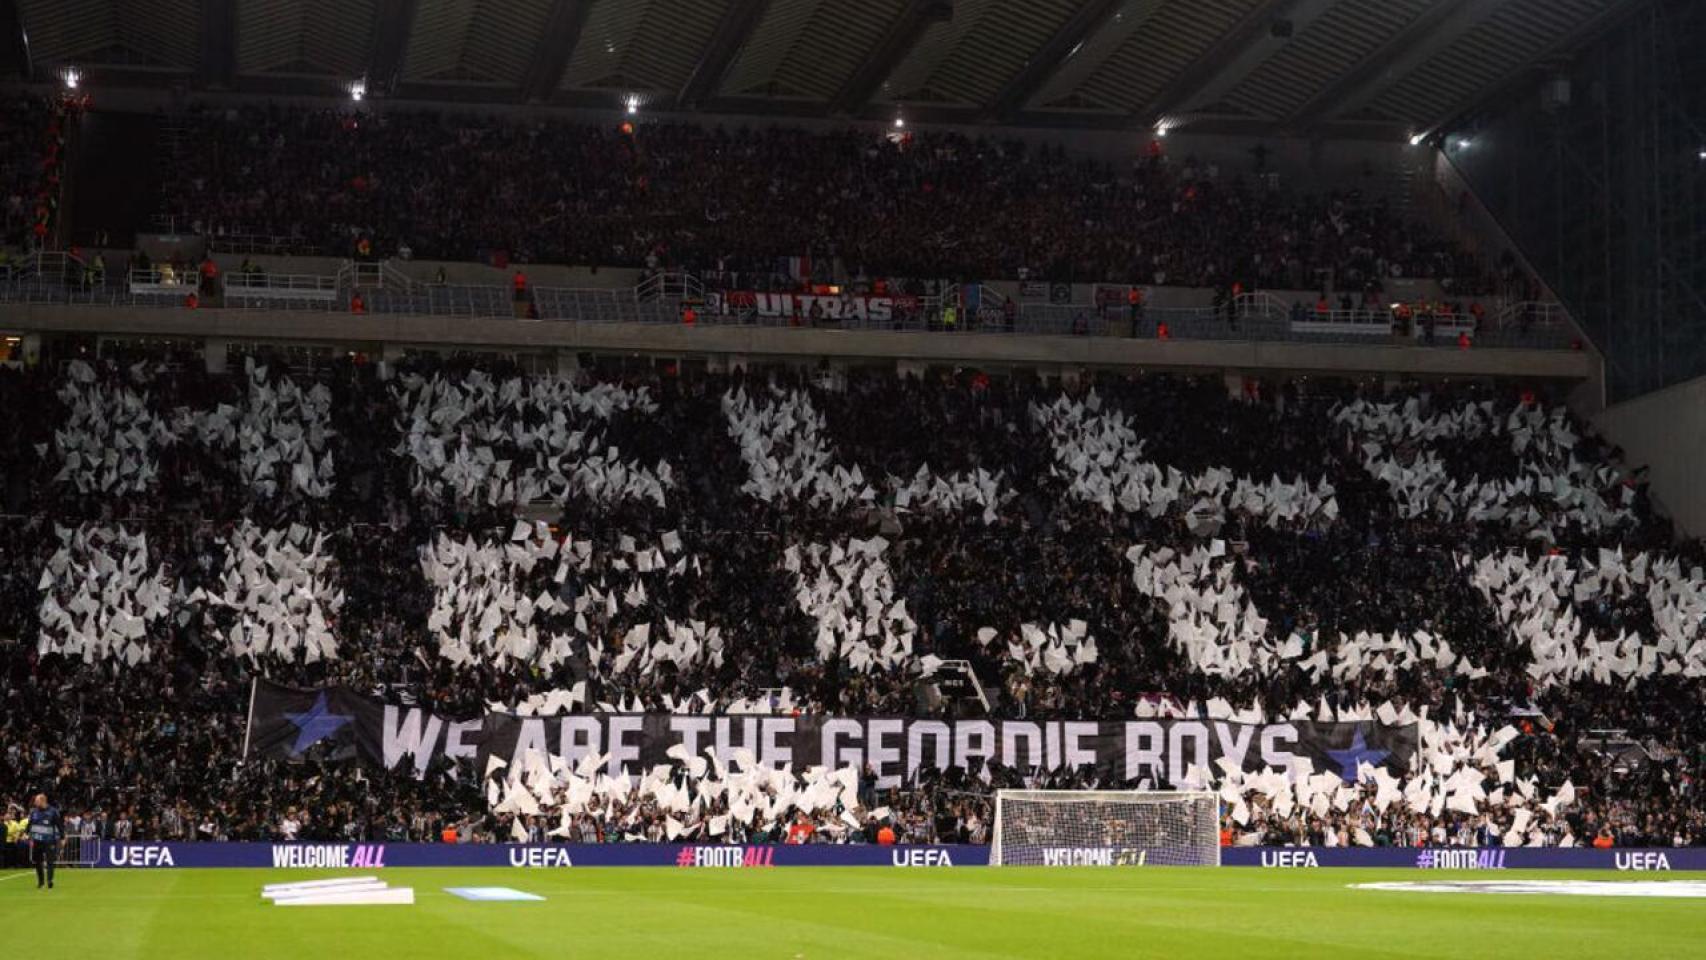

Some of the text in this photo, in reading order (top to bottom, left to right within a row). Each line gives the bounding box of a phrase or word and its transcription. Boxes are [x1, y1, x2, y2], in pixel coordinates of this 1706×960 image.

[755, 292, 893, 320] ULTRAS
[382, 704, 1299, 791] WE ARE THE GEORDIE BOYS
[109, 845, 174, 866] UEFA
[272, 844, 385, 868] WELCOME ALL
[509, 847, 571, 867] UEFA
[677, 846, 775, 868] #FOOTBALL
[892, 848, 952, 867] UEFA
[1261, 850, 1319, 868] UEFA
[1417, 849, 1506, 869] #FOOTBALL
[1614, 851, 1671, 871] UEFA
